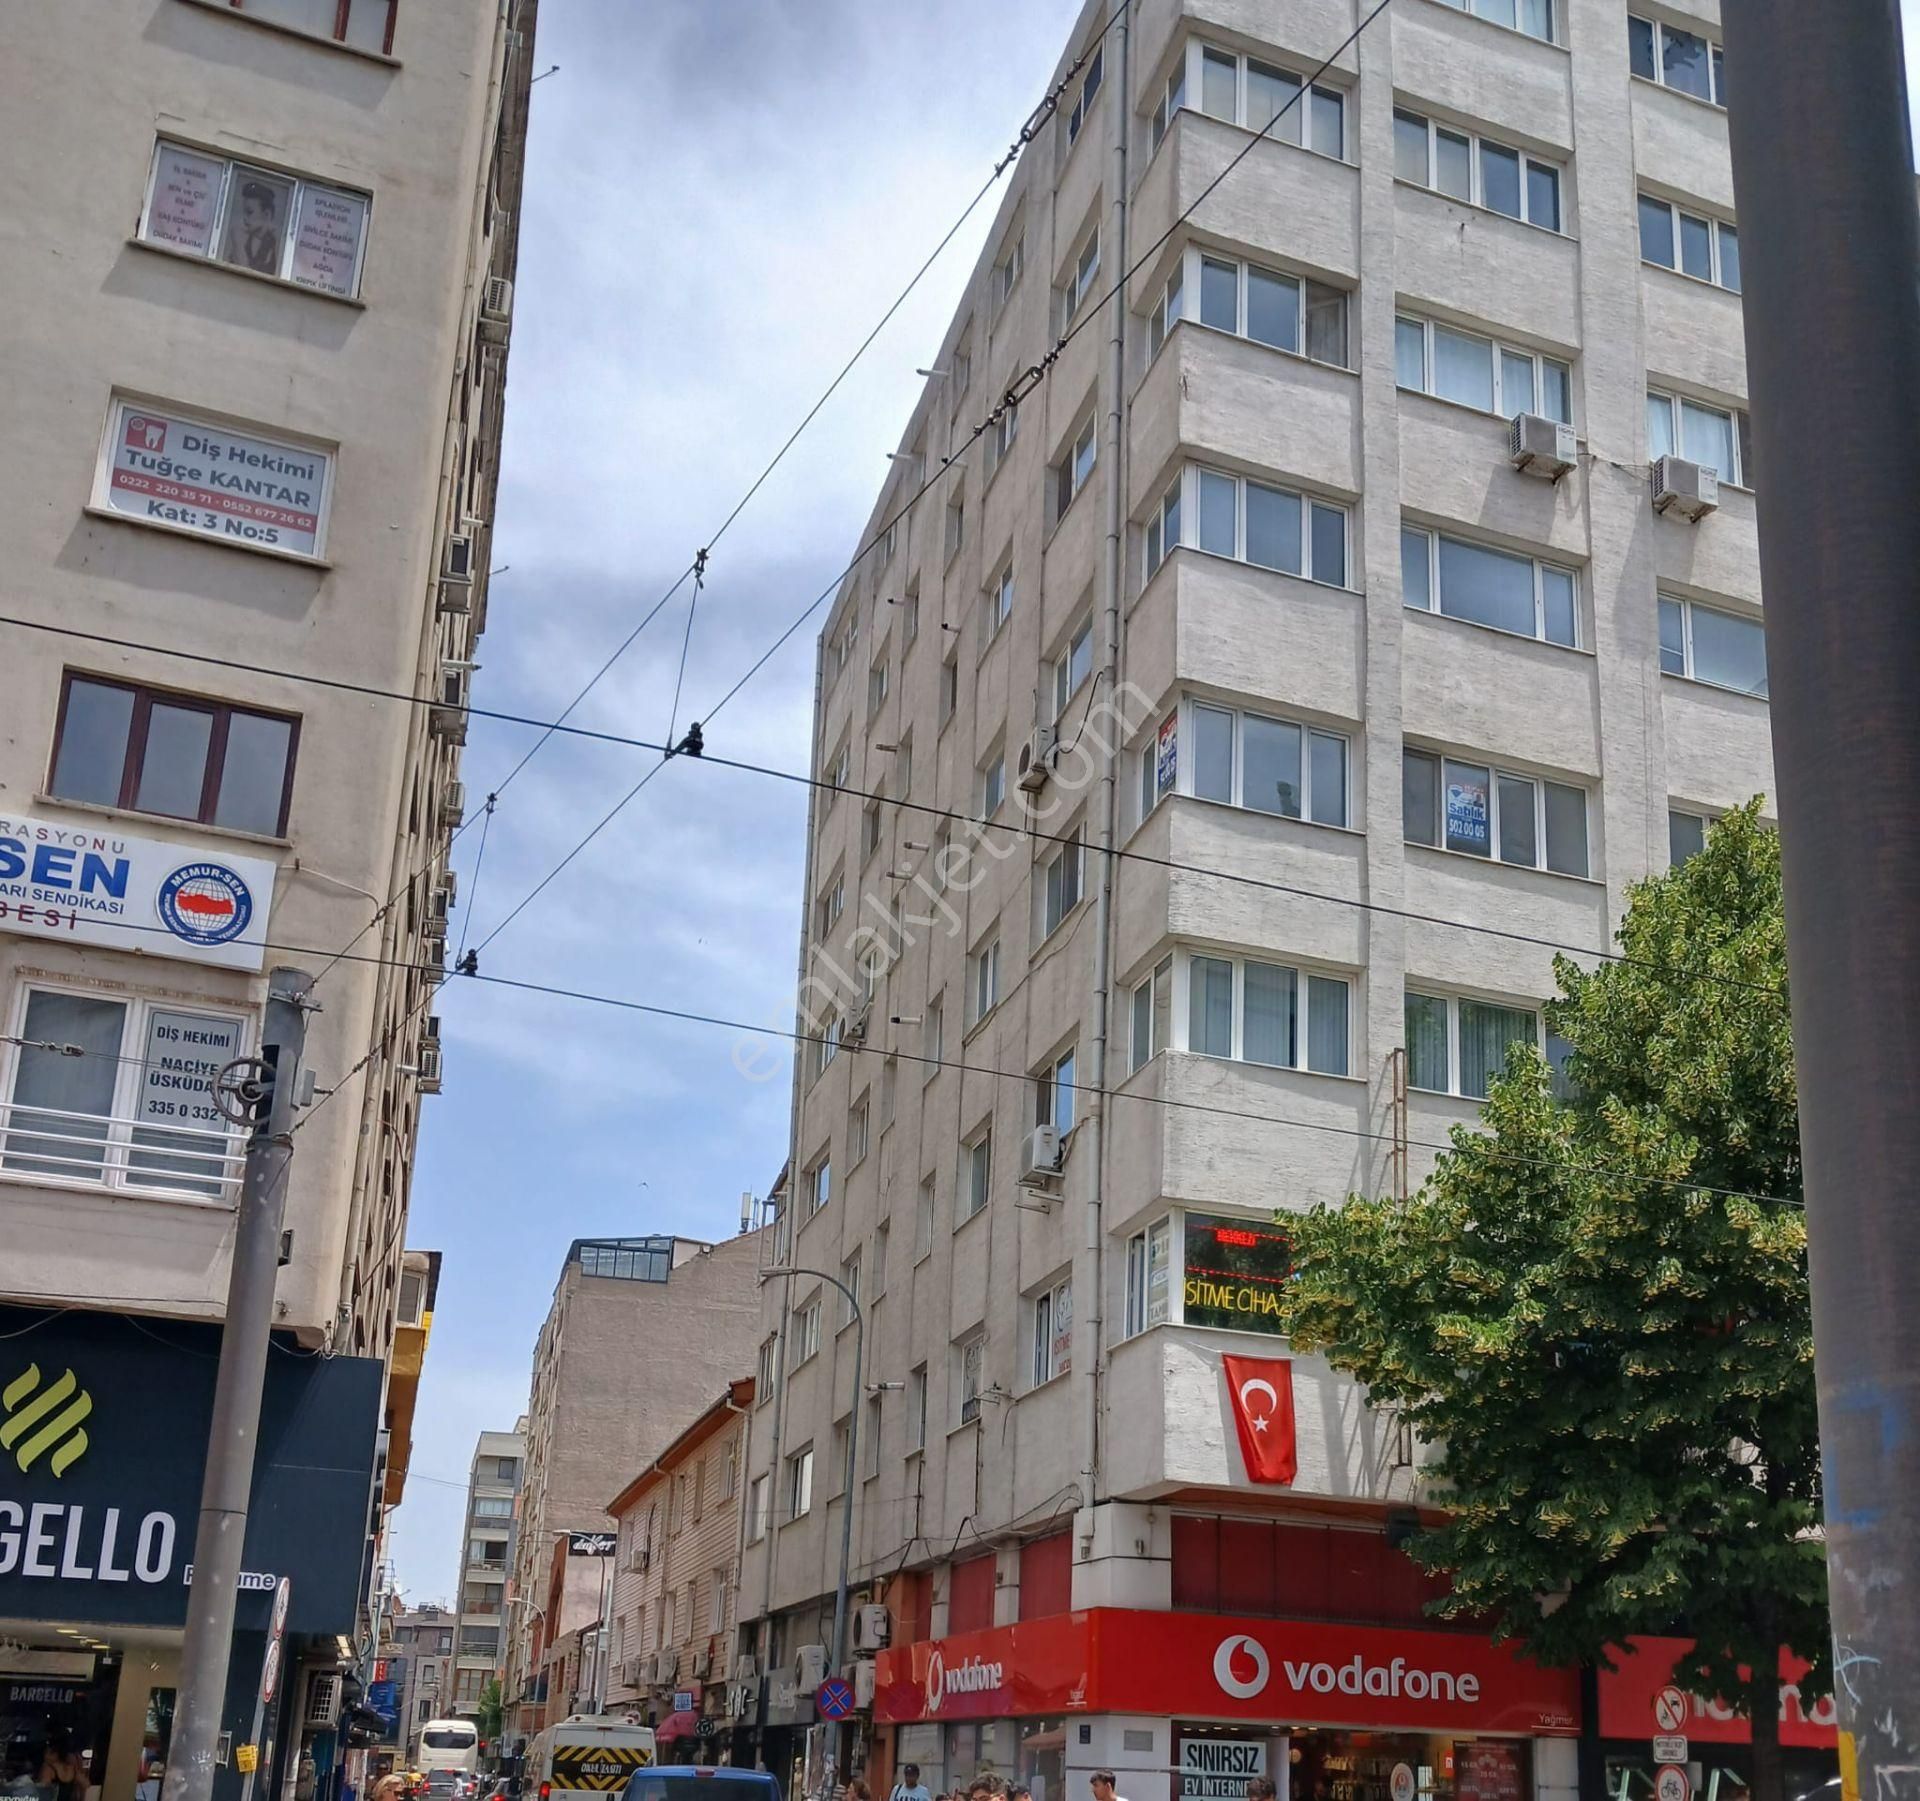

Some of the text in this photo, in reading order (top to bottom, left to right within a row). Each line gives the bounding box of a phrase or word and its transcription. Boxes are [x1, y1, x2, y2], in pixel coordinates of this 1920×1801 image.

[182, 435, 314, 480] Diş Hekimi
[126, 450, 310, 508] Tuğçe KANTAR
[119, 474, 149, 489] 0222
[155, 484, 178, 496] 220
[181, 489, 197, 501] 35
[199, 494, 212, 504] 71
[223, 500, 251, 514] 0552
[255, 508, 277, 520] 677
[279, 514, 295, 524] 26
[147, 500, 278, 544] Kat: 3 No:5
[0, 821, 124, 854] RASYONU
[0, 837, 130, 899] SEN
[170, 866, 245, 896] MEMUR-SEN
[32, 888, 124, 915] SENDİKASI
[157, 1025, 230, 1047] DİŞ HEKİMİ
[150, 1071, 225, 1094] ÜSKÜDA
[161, 1057, 219, 1075] NACİYE
[149, 1100, 175, 1115] 335
[192, 1106, 218, 1120] 332
[0, 1500, 176, 1583] GELLO
[945, 1655, 1002, 1694] vodafone
[1283, 1655, 1480, 1701] vodafone
[1187, 1744, 1259, 1773] SINIRSIZ
[1184, 1777, 1199, 1795] EV
